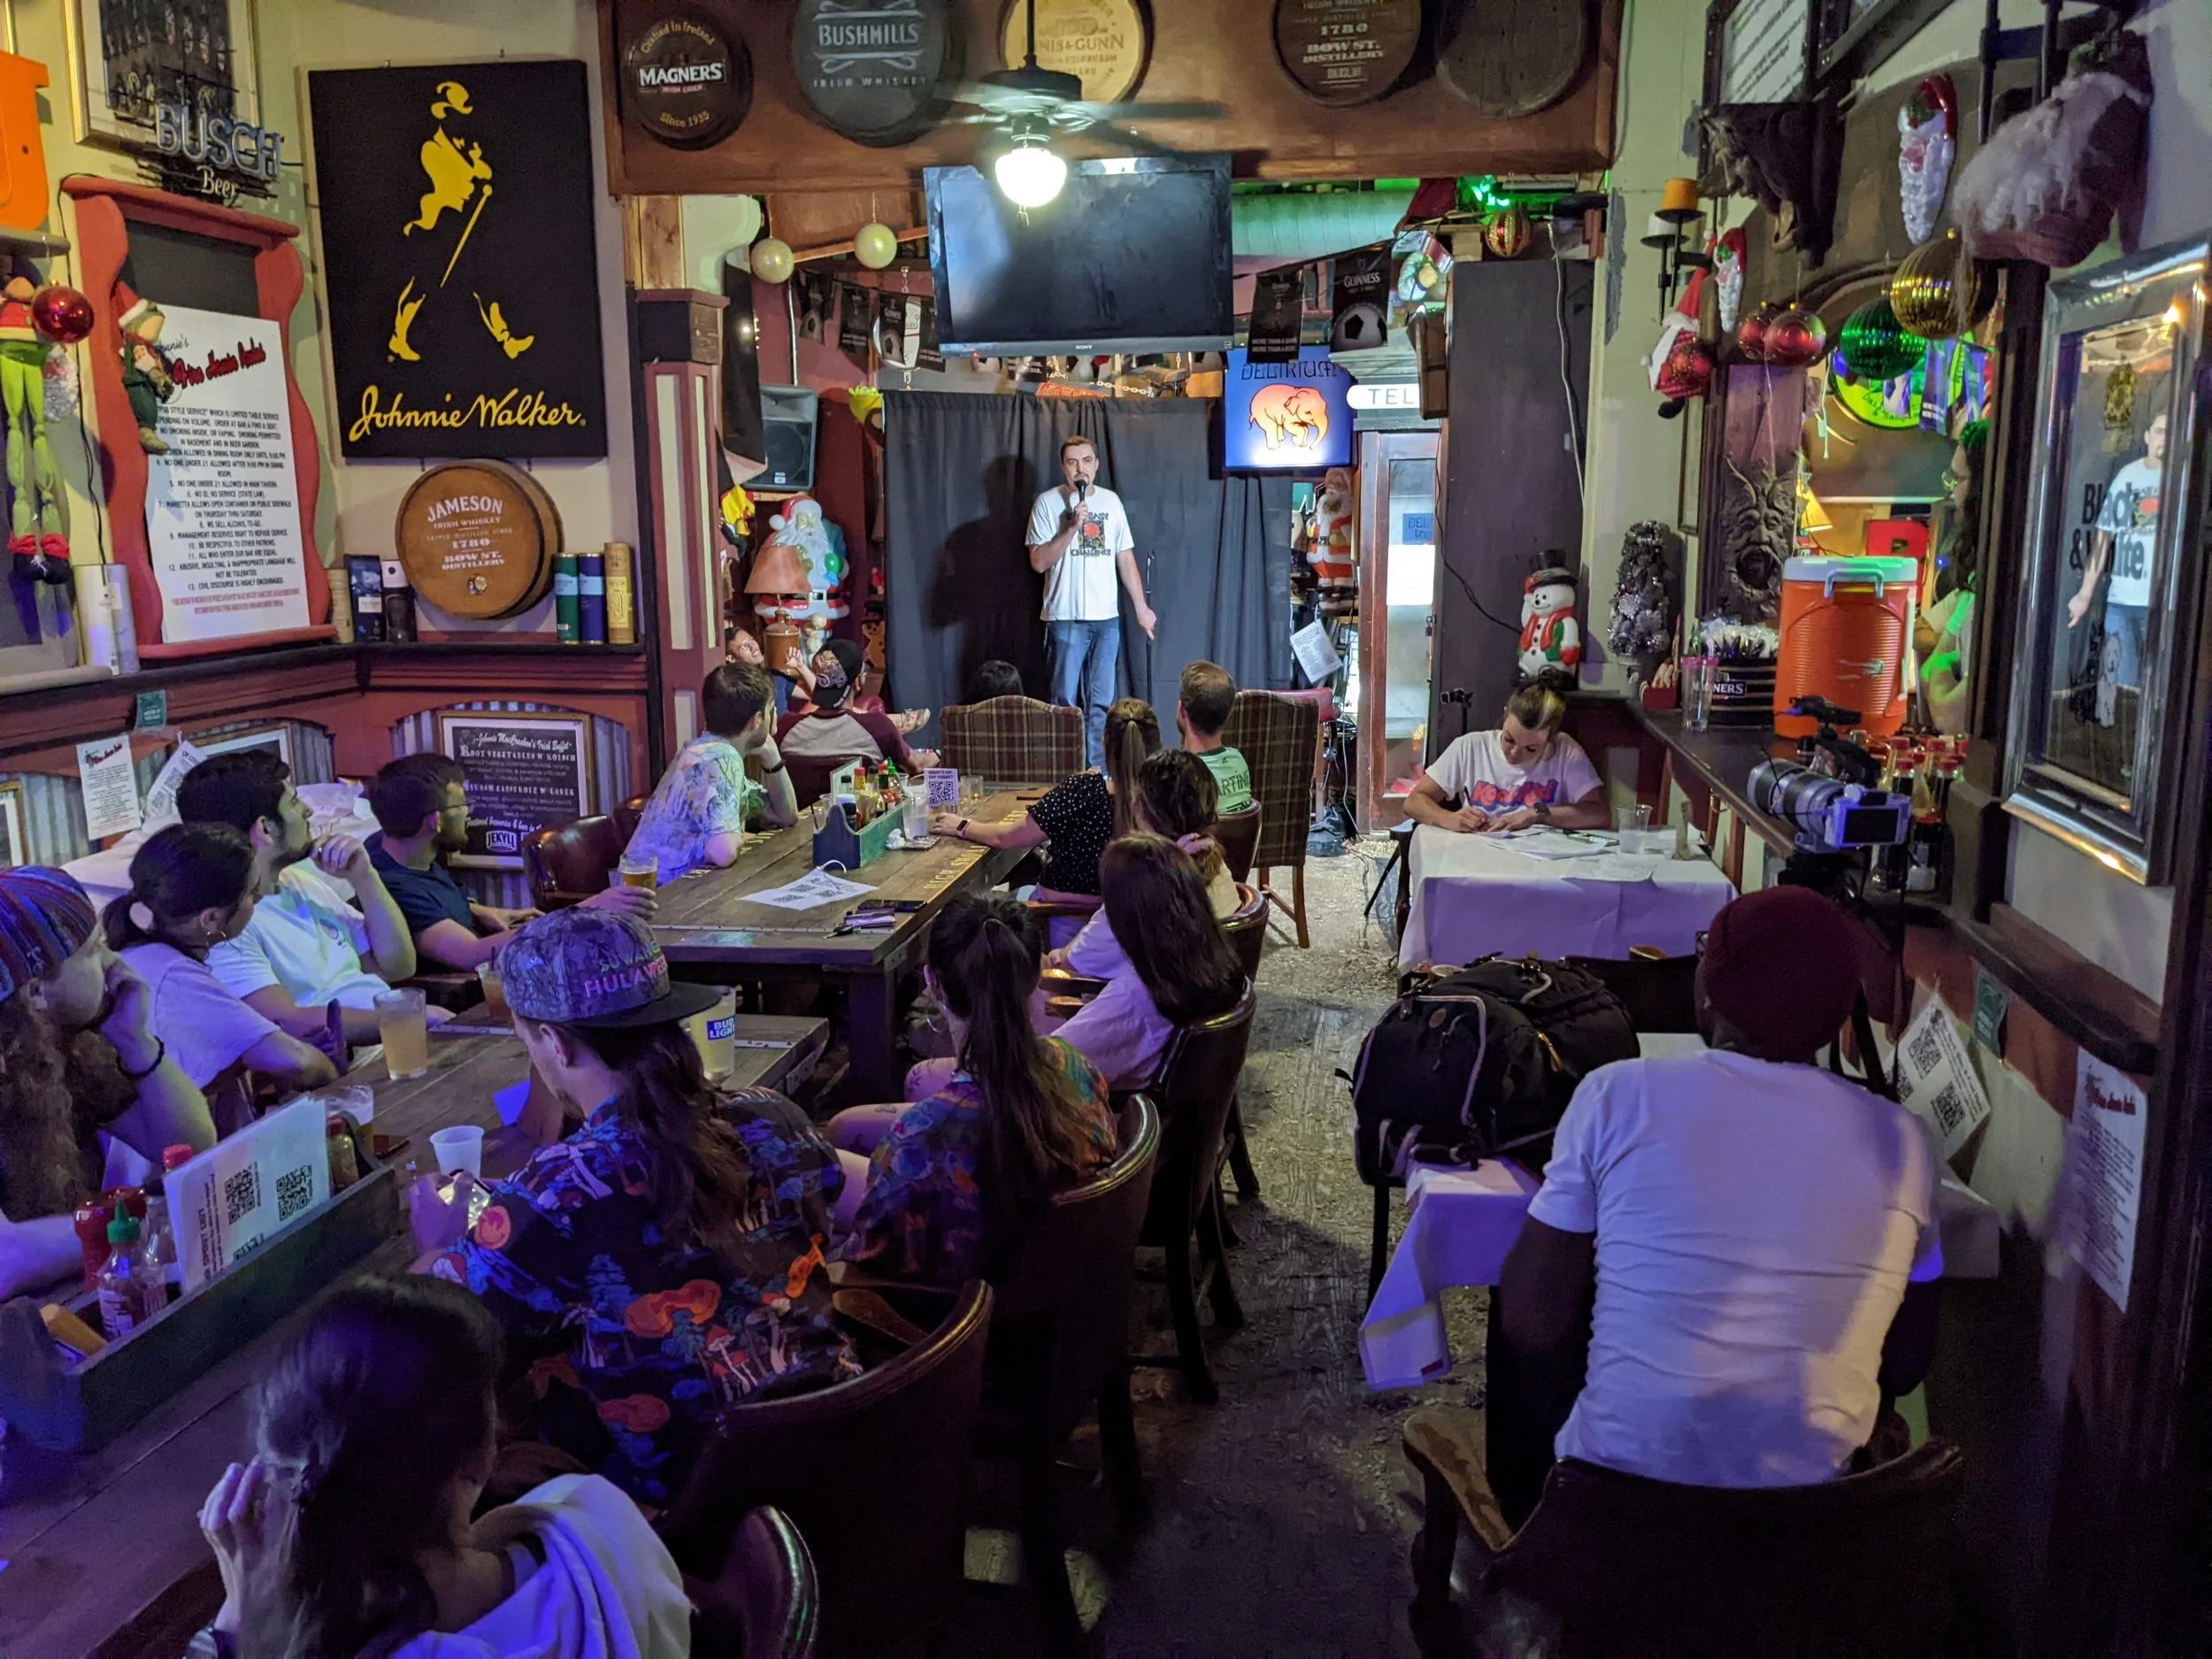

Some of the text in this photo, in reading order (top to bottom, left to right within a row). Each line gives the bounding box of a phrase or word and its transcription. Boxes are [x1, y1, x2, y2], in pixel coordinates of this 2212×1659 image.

[818, 23, 919, 46] BUSHMILLS
[1307, 42, 1350, 54] BOW
[639, 62, 723, 87] MAGNERS
[155, 103, 281, 182] BUSCH
[196, 165, 239, 199] Beer
[1344, 272, 1380, 288] GUINNESS
[1240, 361, 1338, 380] DELIRIUM
[349, 385, 581, 442] Johnnie Walker
[427, 495, 503, 522] JAMESON
[434, 516, 502, 530] IRISH WHISKEY
[444, 553, 478, 563] BOW
[2070, 527, 2083, 571] &
[488, 750, 534, 759] VEGETABLES
[714, 1017, 734, 1031] BUD
